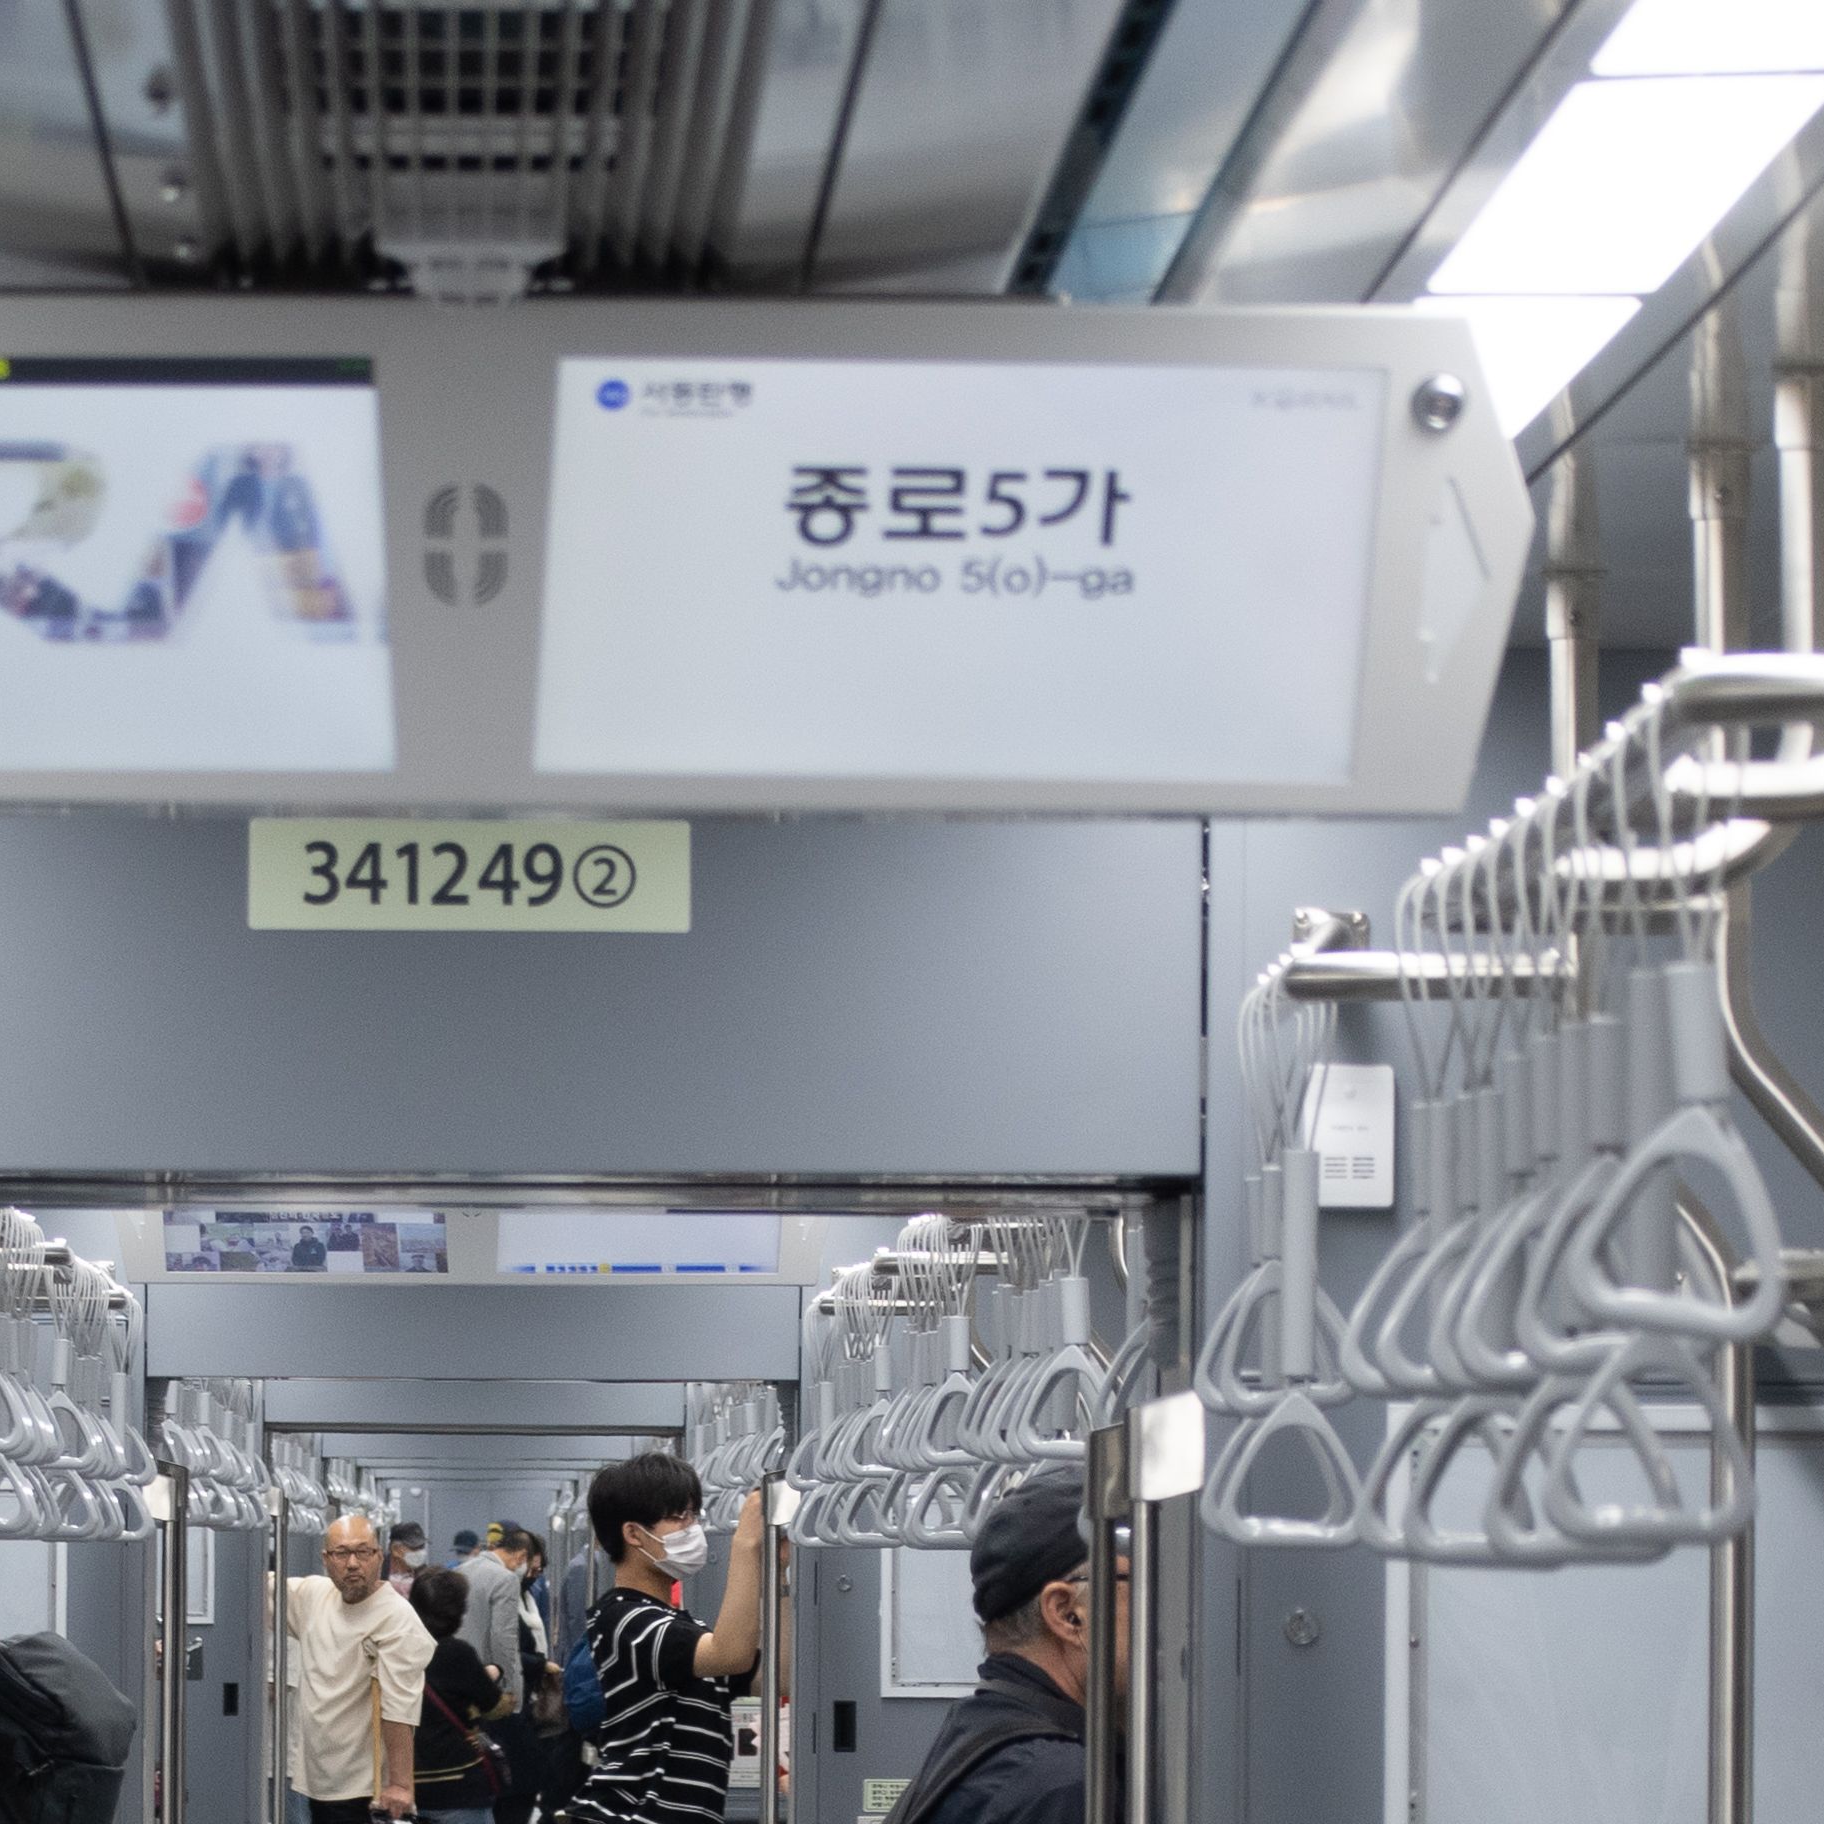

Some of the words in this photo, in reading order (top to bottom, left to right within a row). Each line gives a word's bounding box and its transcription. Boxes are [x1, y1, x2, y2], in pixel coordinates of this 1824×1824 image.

[785, 466, 1132, 548] 종로5가
[777, 556, 942, 599] Jongno
[960, 554, 1135, 601] 5(o)-ga
